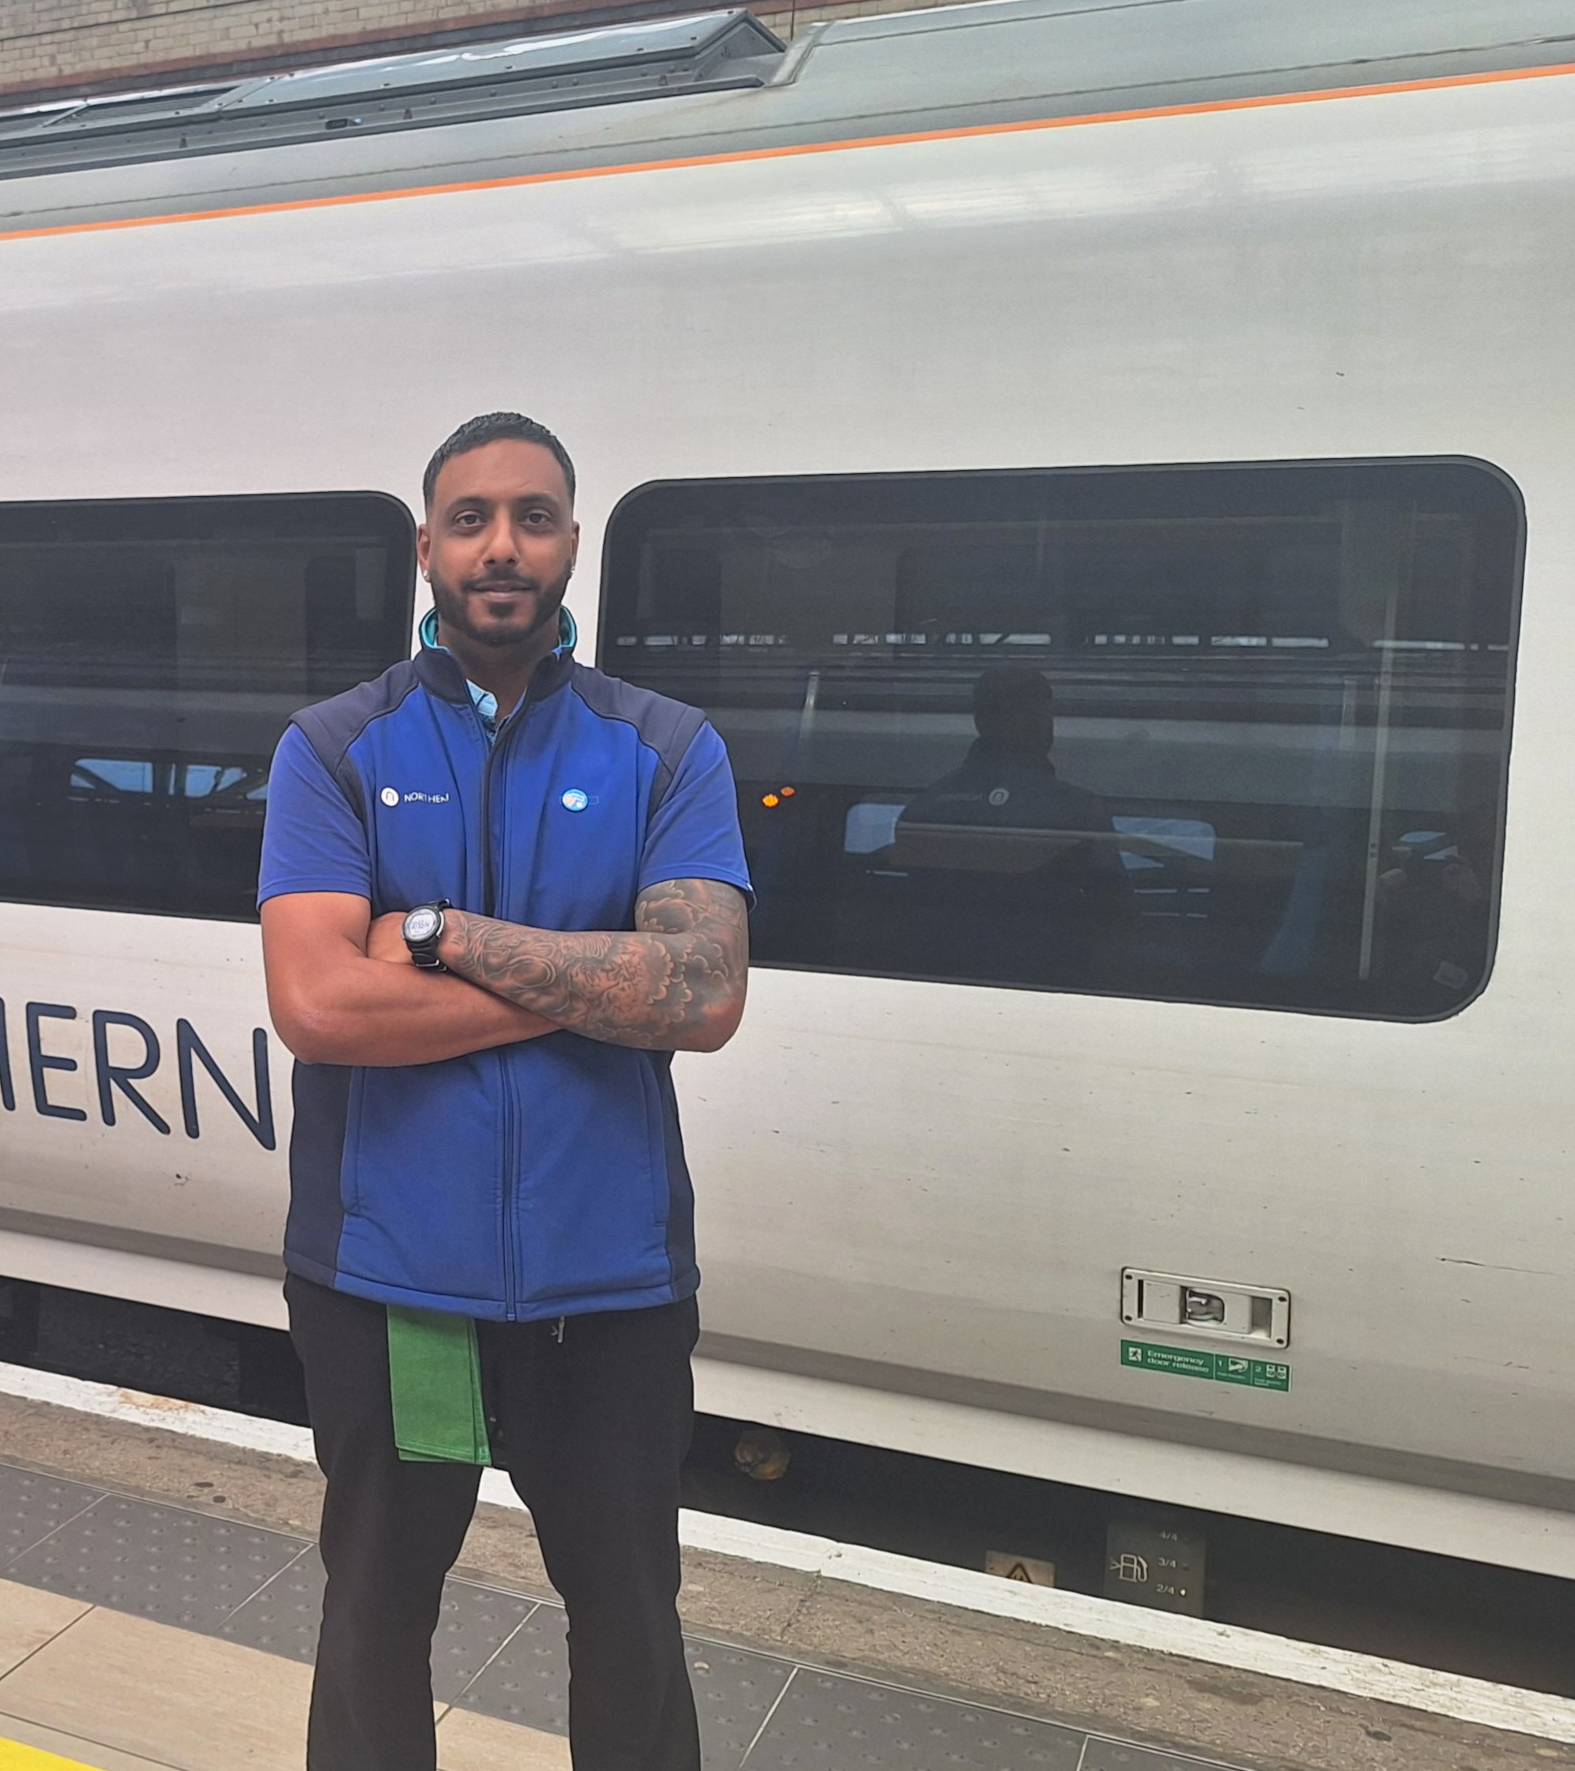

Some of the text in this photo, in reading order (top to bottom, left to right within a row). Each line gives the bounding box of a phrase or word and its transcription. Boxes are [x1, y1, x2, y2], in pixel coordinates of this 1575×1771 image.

[1147, 1350, 1205, 1366] Emergency
[1147, 1357, 1210, 1373] door release
[1159, 1530, 1178, 1541] 4/4
[1158, 1557, 1177, 1568] 3/4
[1156, 1583, 1175, 1595] 2/4
